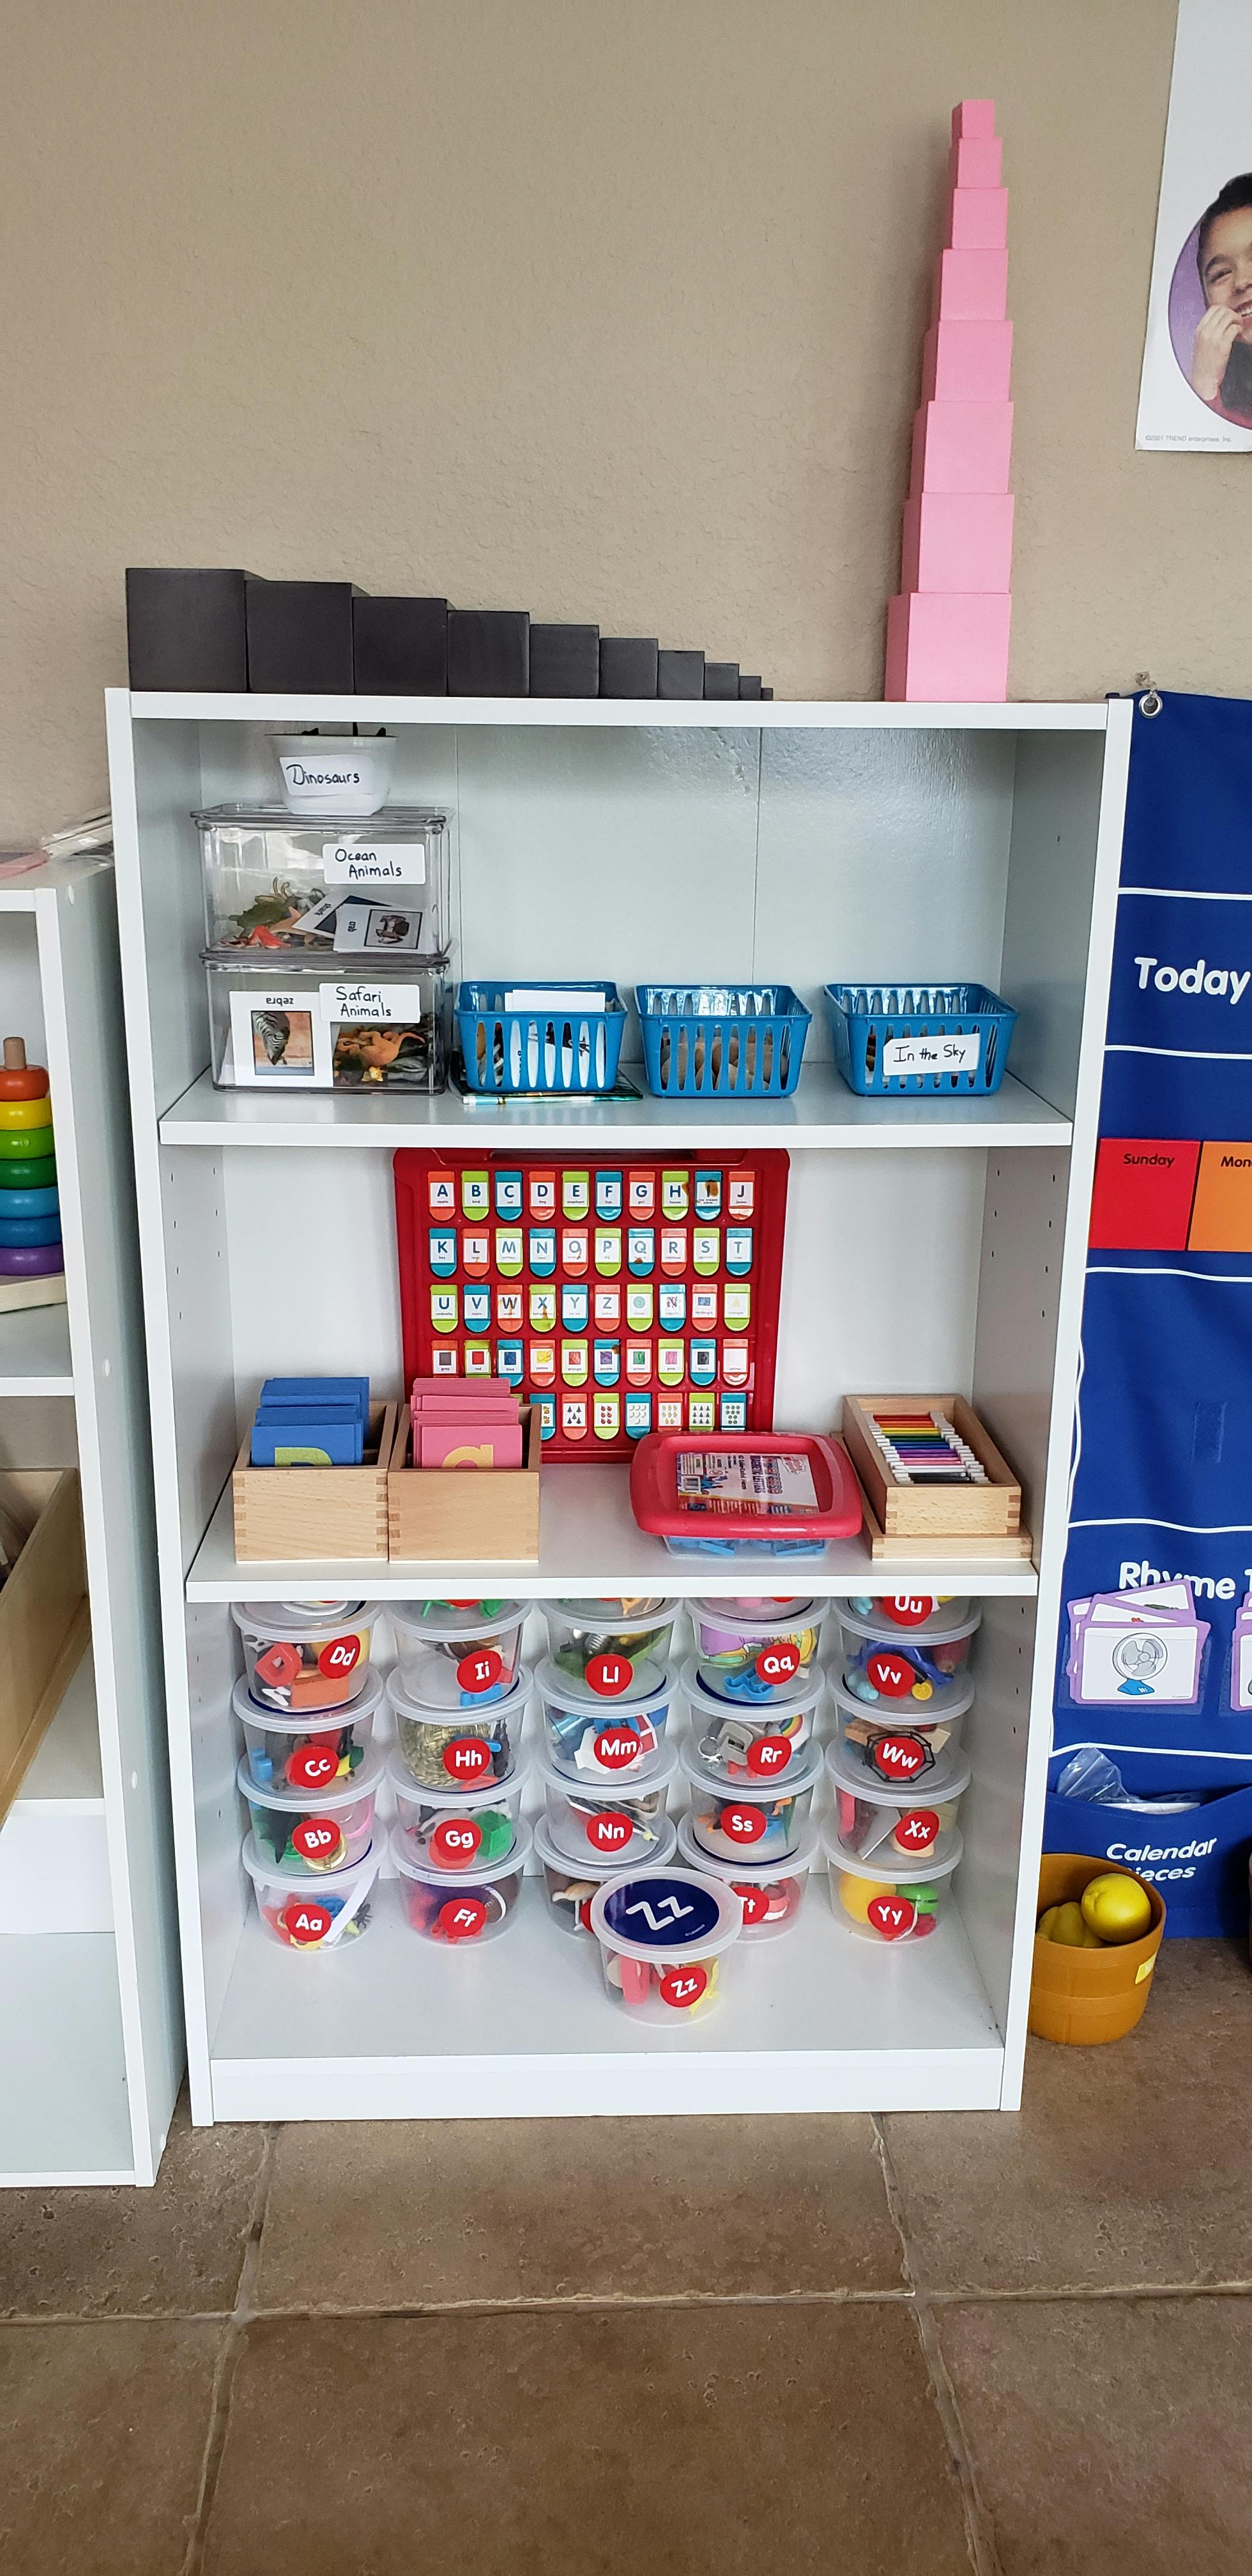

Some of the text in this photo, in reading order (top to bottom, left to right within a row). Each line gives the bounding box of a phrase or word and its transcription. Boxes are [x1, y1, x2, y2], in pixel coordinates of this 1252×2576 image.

[286, 764, 360, 785] Dinosaurs
[335, 848, 377, 862] Ocean
[349, 861, 402, 880] Animals
[1134, 956, 1251, 1004] Today
[336, 986, 382, 1002] Safari
[266, 997, 294, 1007] zebra
[340, 1002, 392, 1017] Animals
[893, 1044, 966, 1063] In the Sky
[1123, 1153, 1175, 1168] Sunday
[1221, 1156, 1252, 1168] Mon
[437, 1184, 448, 1197] A
[471, 1184, 481, 1197] B
[504, 1184, 515, 1199] C
[537, 1184, 548, 1197] D
[572, 1184, 581, 1197] E
[605, 1185, 613, 1198] F
[636, 1184, 648, 1198] G
[669, 1184, 682, 1198] H
[737, 1184, 745, 1198] J
[437, 1240, 448, 1254] K
[473, 1241, 480, 1254] L
[501, 1241, 516, 1254] M
[537, 1241, 548, 1254] N
[569, 1240, 581, 1253] O
[603, 1240, 613, 1253] P
[634, 1240, 647, 1254] Q
[669, 1241, 678, 1254] R
[701, 1240, 710, 1254] S
[733, 1241, 743, 1254] T
[438, 1297, 450, 1310] U
[471, 1296, 482, 1310] V
[502, 1296, 517, 1310] W
[537, 1296, 548, 1310] X
[570, 1296, 580, 1309] Y
[602, 1297, 612, 1309] Z
[894, 1595, 922, 1613] Uu
[329, 1646, 356, 1666] Dd
[475, 1660, 490, 1680] Ii
[763, 1655, 795, 1674] Qq
[876, 1664, 901, 1684] Vv
[601, 1738, 637, 1756] Mm
[455, 1749, 482, 1767] Hh
[760, 1747, 782, 1763] Rr
[882, 1743, 919, 1768] Ww
[305, 1759, 331, 1777] Cc
[731, 1814, 753, 1832] Ss
[904, 1820, 931, 1839] Xx
[304, 1829, 332, 1848] Bb
[598, 1823, 625, 1839] Nn
[445, 1830, 474, 1849] Gg
[1106, 1838, 1217, 1862] Calendar
[1127, 1866, 1196, 1882] ieces
[453, 1908, 478, 1928] Ff
[625, 1896, 694, 1931] Zz
[878, 1905, 903, 1926] Yy
[295, 1913, 323, 1931] Aa
[671, 1978, 698, 1998] Zz
